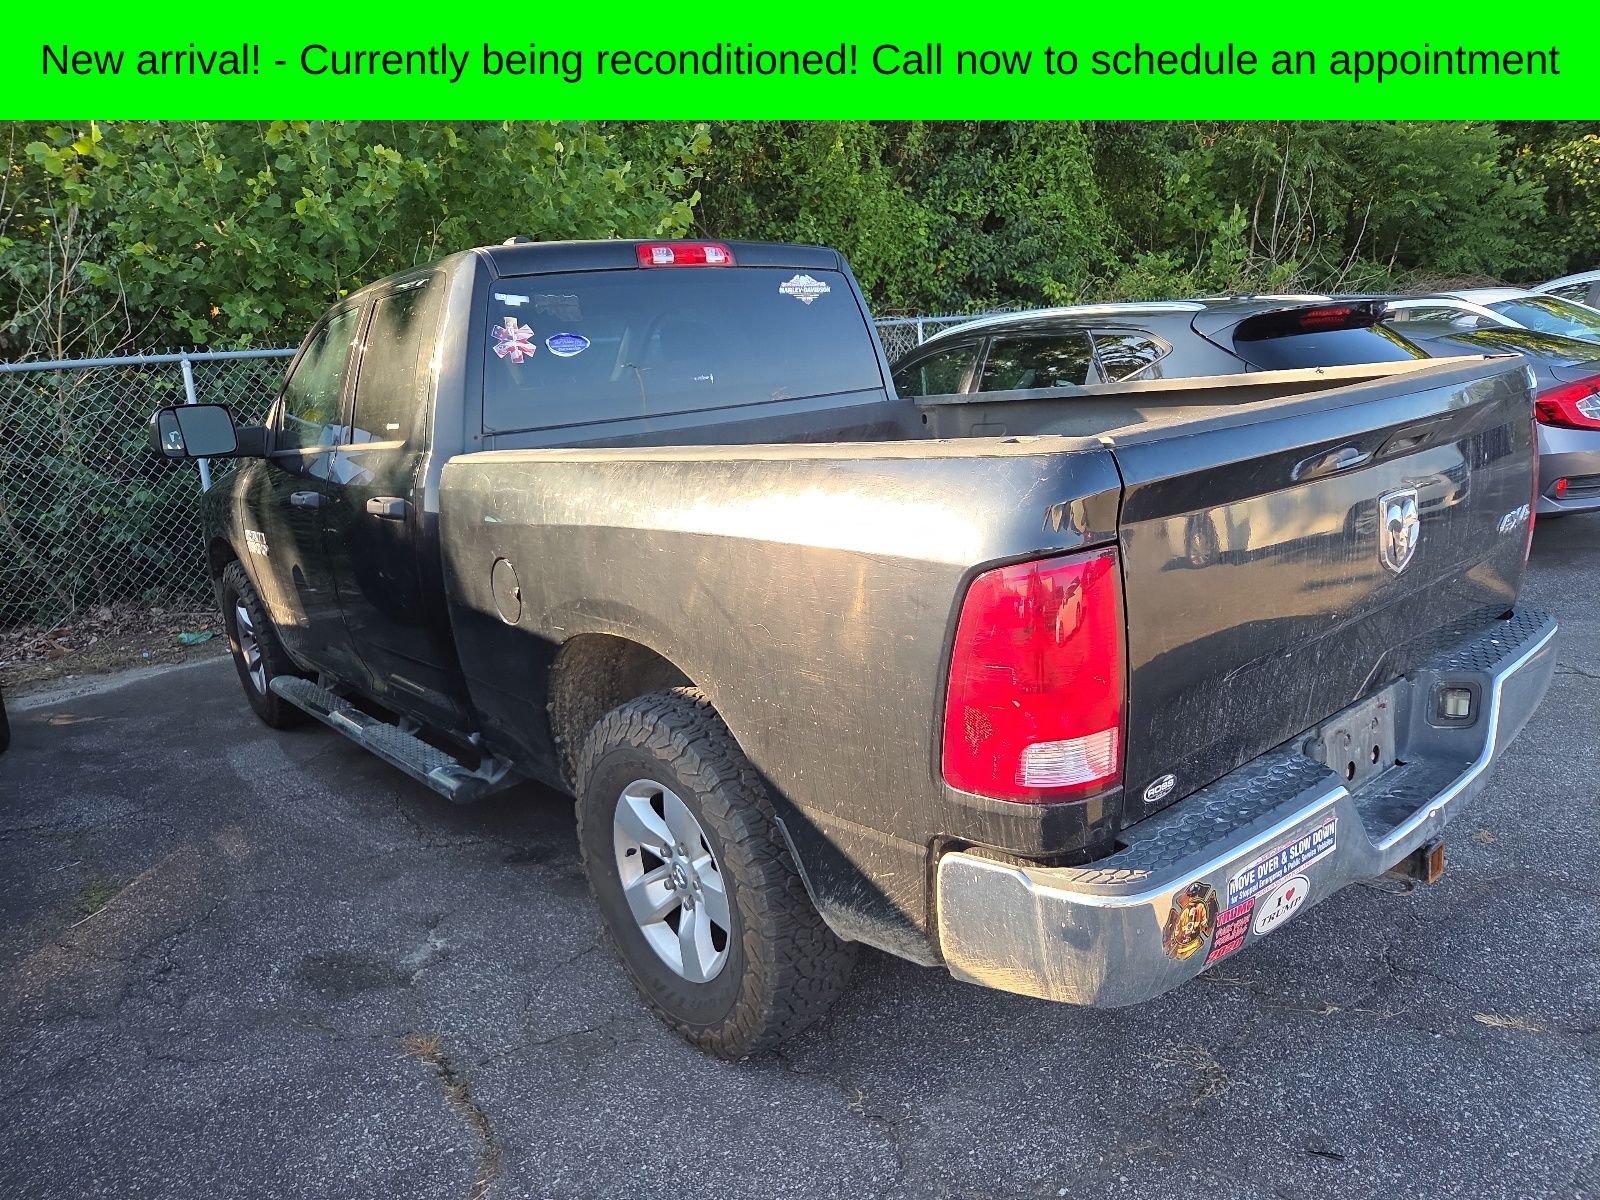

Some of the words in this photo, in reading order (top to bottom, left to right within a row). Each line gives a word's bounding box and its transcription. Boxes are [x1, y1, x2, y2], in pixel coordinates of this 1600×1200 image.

[1148, 778, 1175, 798] ROSS
[1230, 870, 1256, 895] MOVE
[1257, 855, 1279, 879] OVER
[1281, 851, 1288, 865] &
[1290, 835, 1311, 859] SLOW
[1313, 822, 1335, 844] DOWN
[1259, 869, 1283, 888] Emergency
[1216, 897, 1255, 928] TRUMP
[1260, 896, 1301, 927] TRUMP
[1276, 895, 1283, 908] I
